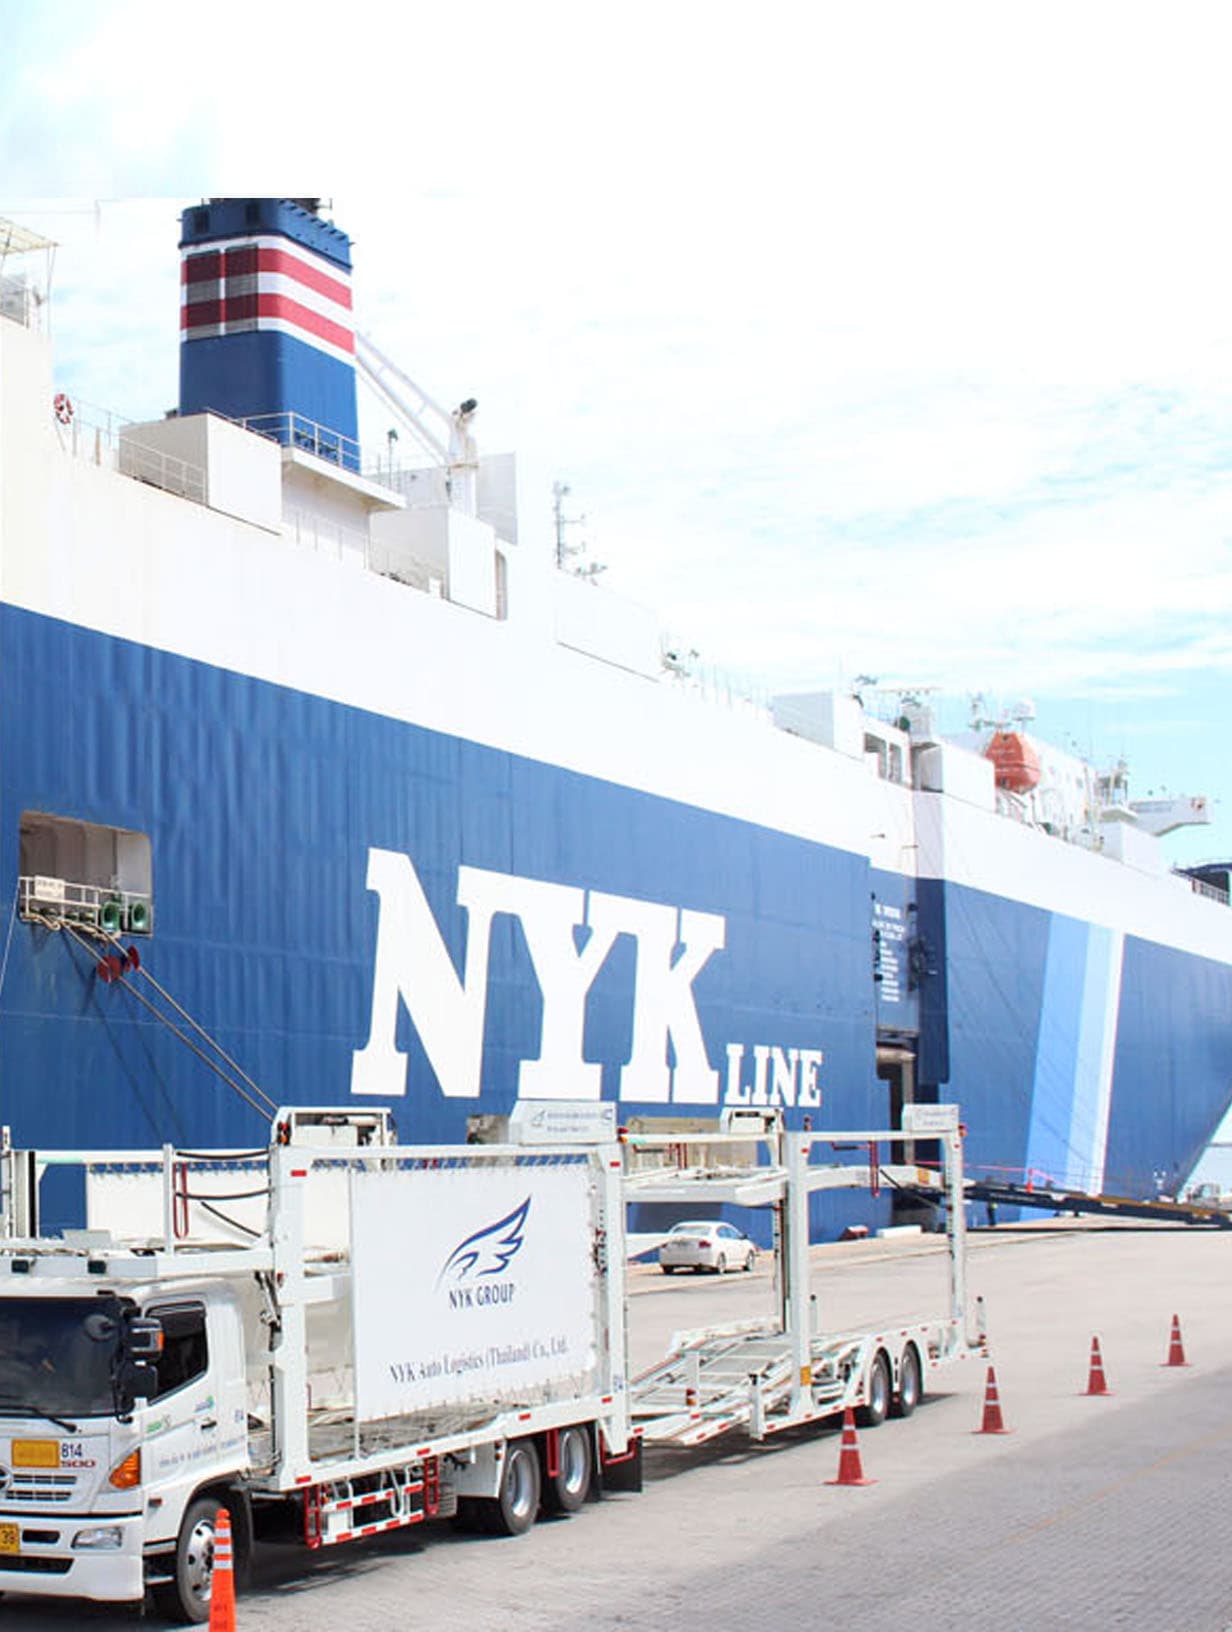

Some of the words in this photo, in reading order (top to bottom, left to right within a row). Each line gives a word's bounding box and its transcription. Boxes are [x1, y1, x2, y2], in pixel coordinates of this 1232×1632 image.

[350, 847, 726, 1105] NYK
[724, 1044, 822, 1108] LINE
[449, 1288, 473, 1308] NYK
[476, 1283, 515, 1306] GROUP
[389, 1363, 416, 1383] NYK
[420, 1362, 441, 1379] Auto
[443, 1354, 484, 1376] Logistics
[61, 1443, 83, 1458] 814
